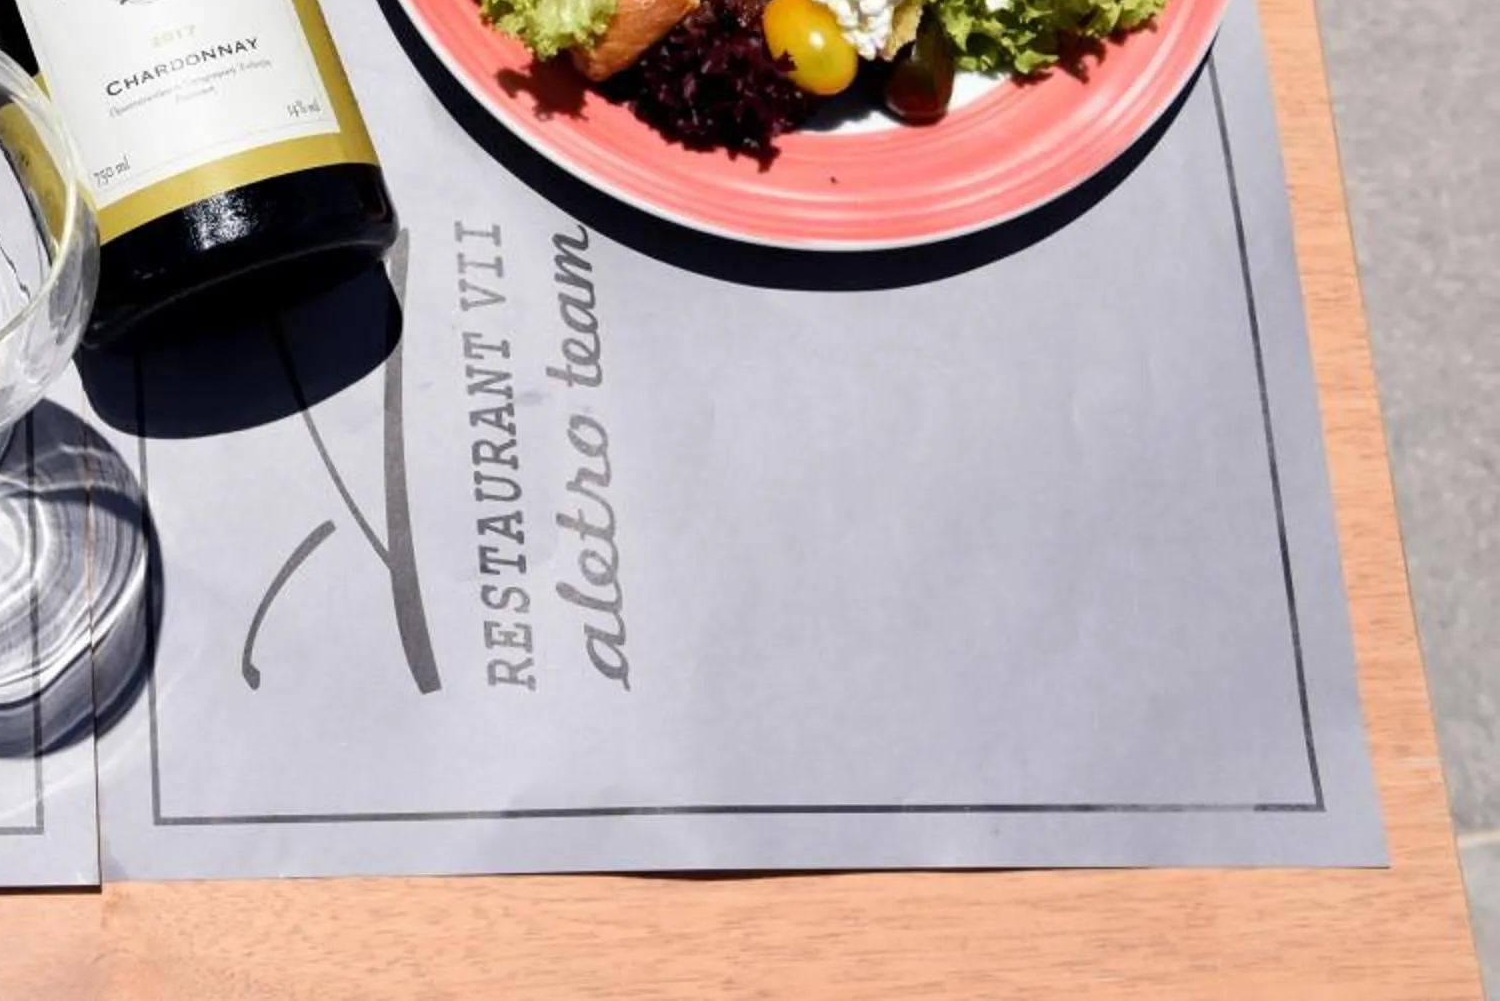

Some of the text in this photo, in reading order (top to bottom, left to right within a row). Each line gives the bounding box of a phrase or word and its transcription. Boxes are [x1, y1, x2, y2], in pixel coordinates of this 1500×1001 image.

[93, 155, 131, 187] 750 ml
[105, 37, 258, 97] CHARDONNAY
[454, 221, 536, 692] RESTAURANT VII
[545, 225, 631, 692] aletro team
